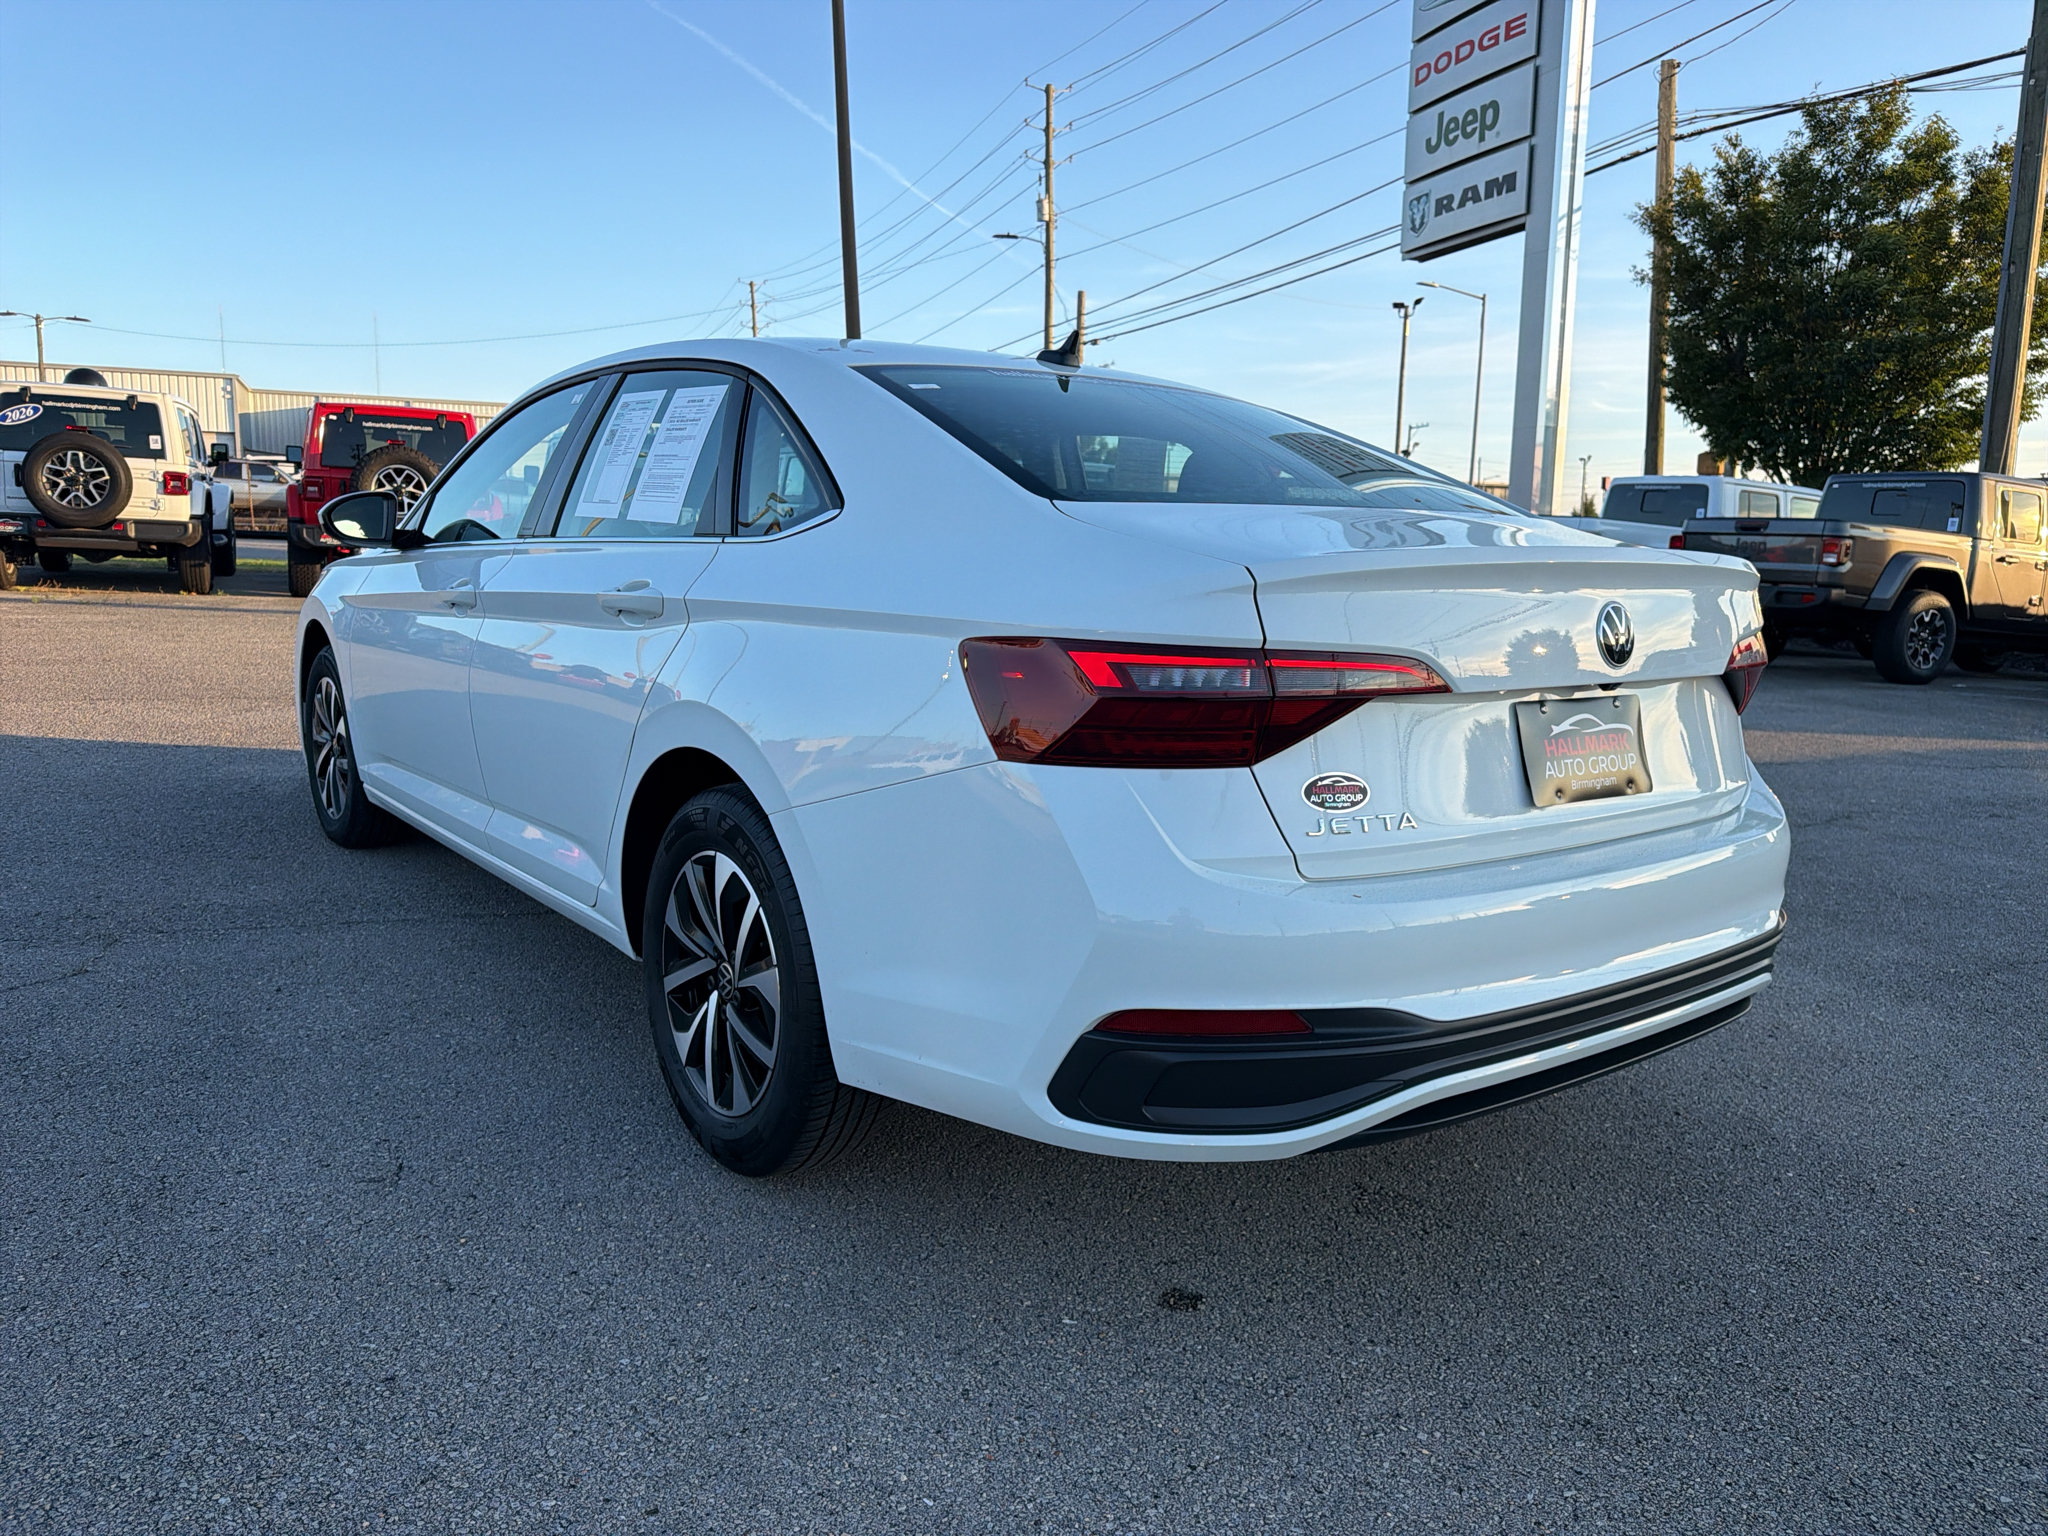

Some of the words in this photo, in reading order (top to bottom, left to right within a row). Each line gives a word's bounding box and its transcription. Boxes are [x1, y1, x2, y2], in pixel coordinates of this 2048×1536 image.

[1414, 12, 1528, 88] DODGE
[1425, 99, 1500, 155] Jeep
[1434, 170, 1518, 218] RAM
[5, 405, 34, 423] 2026
[1544, 733, 1631, 758] HALLMARK
[1545, 758, 1586, 779] AUTO
[1588, 753, 1637, 774] GROUP
[1312, 785, 1361, 794] HALLMARK
[1571, 776, 1618, 790] Birmingham
[1310, 794, 1333, 803] AUTO
[1335, 793, 1364, 802] GROUP
[1306, 812, 1418, 836] JETTA
